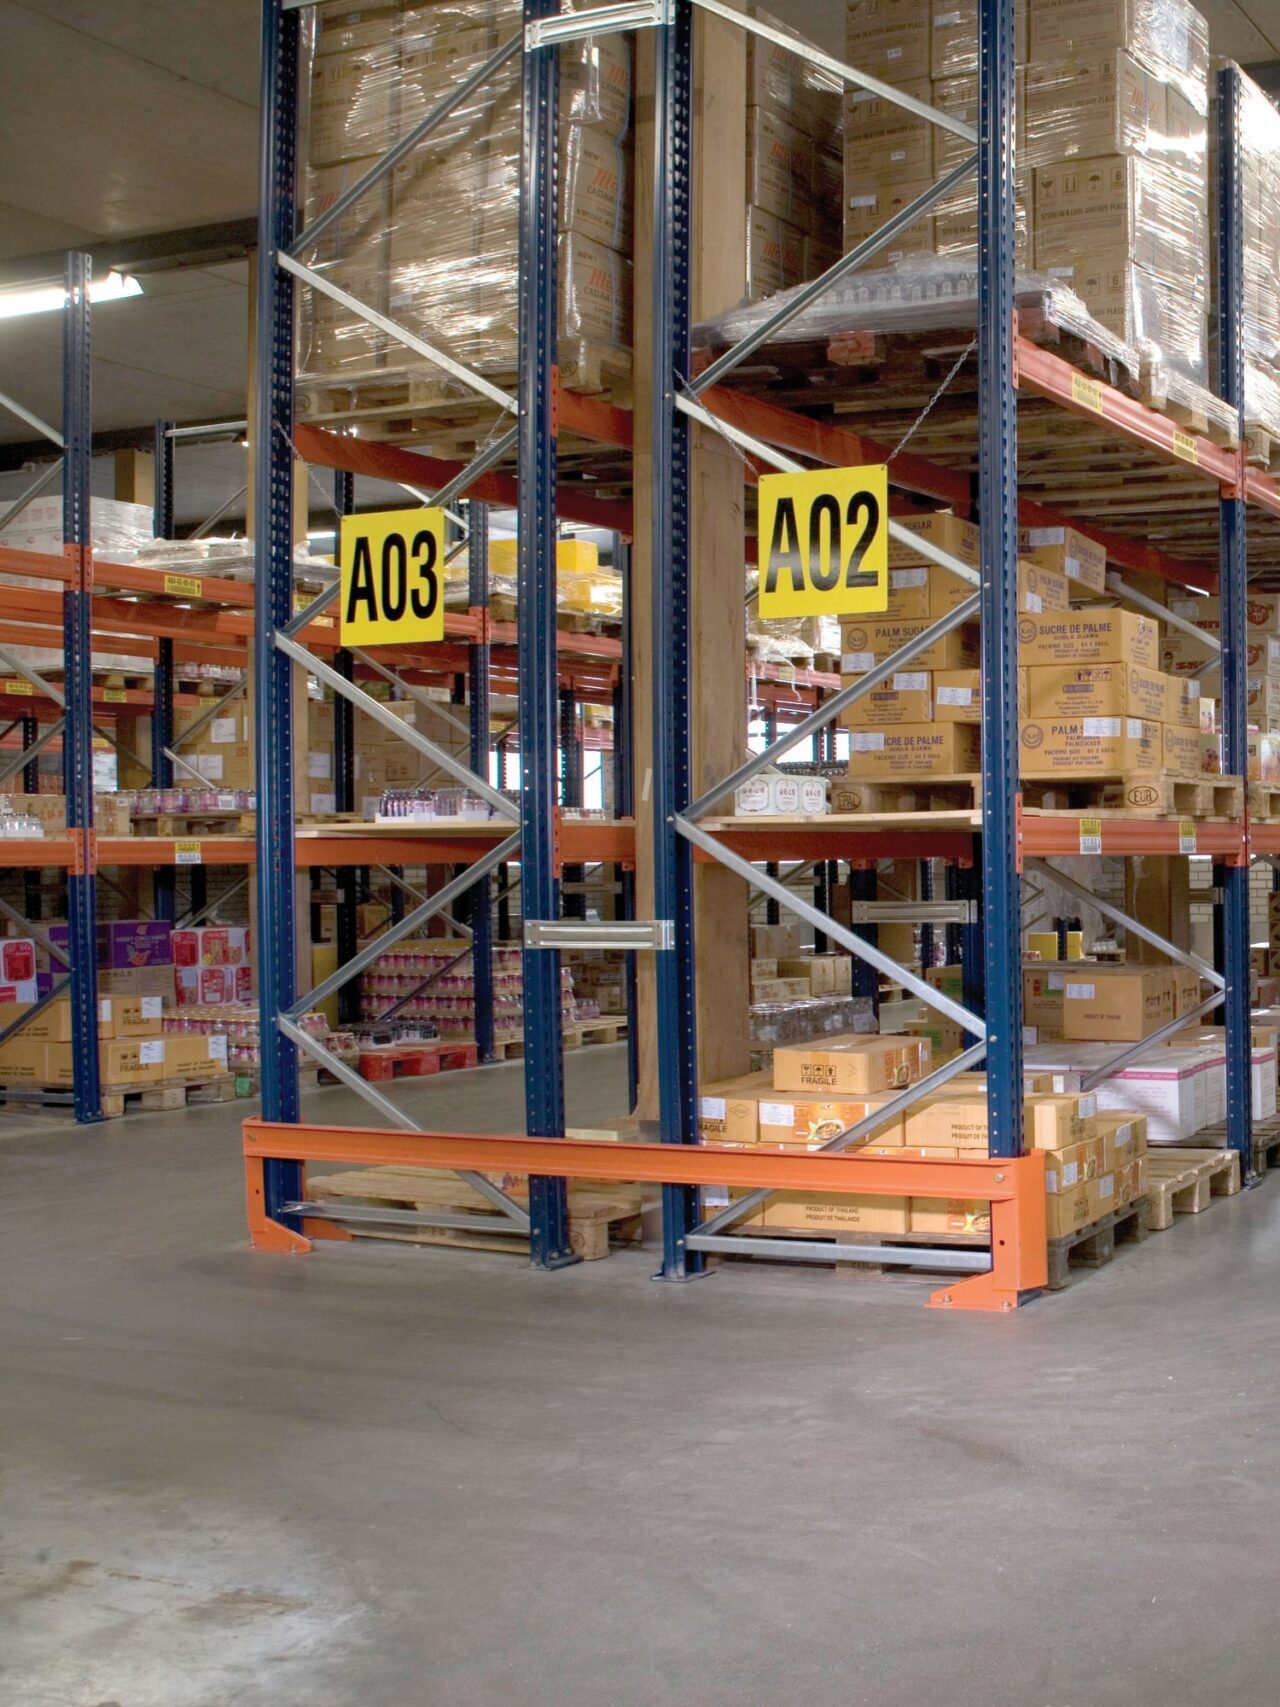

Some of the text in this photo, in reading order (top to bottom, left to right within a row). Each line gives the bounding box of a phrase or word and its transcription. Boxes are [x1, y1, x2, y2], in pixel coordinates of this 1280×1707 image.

[765, 491, 879, 593] A02
[346, 530, 438, 623] A03
[875, 626, 929, 638] PALM SUGA
[1039, 622, 1112, 636] SUCRE DE PALME
[1051, 725, 1078, 735] PALM
[904, 736, 914, 746] DE
[916, 735, 945, 745] PALME
[119, 1064, 150, 1072] FRAGILE
[801, 1076, 837, 1086] FRAGILE
[699, 1123, 728, 1133] RAGILE
